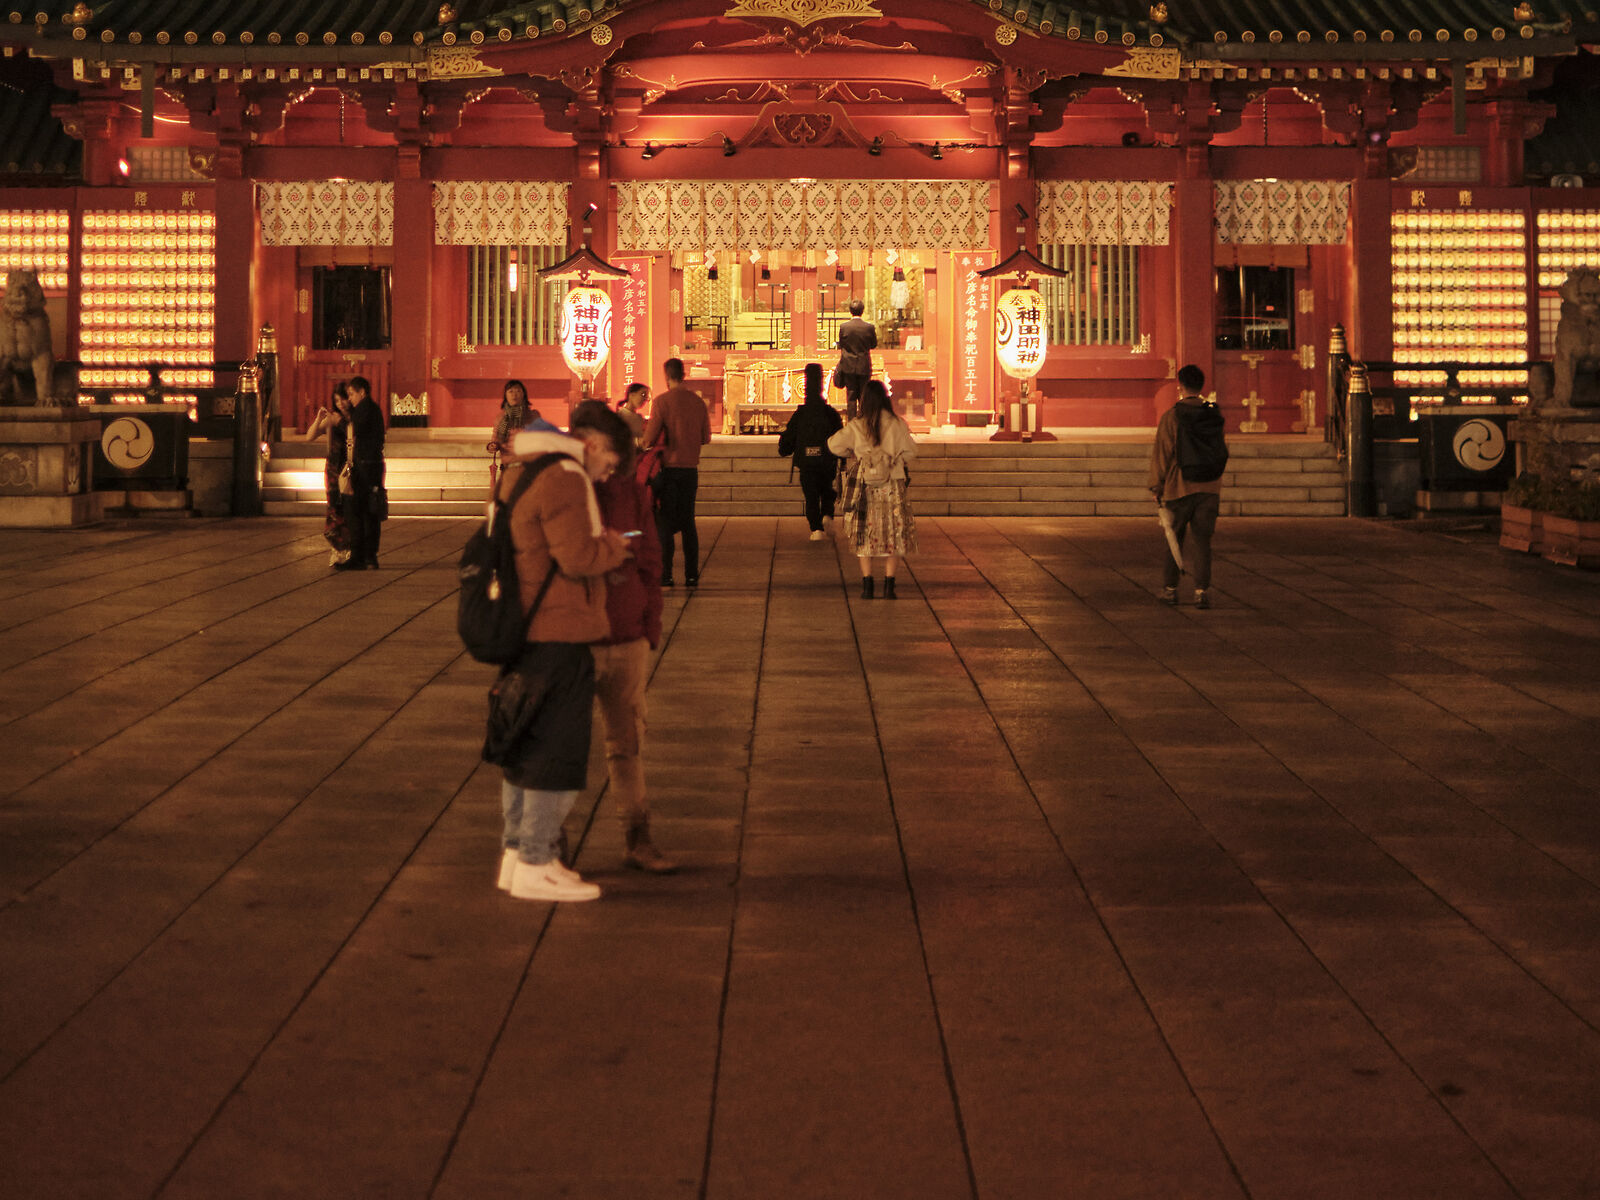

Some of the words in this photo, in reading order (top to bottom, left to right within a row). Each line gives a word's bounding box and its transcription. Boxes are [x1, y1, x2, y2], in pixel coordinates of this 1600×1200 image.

[573, 305, 600, 362] 神田明神
[1016, 306, 1040, 364] 神田明神
